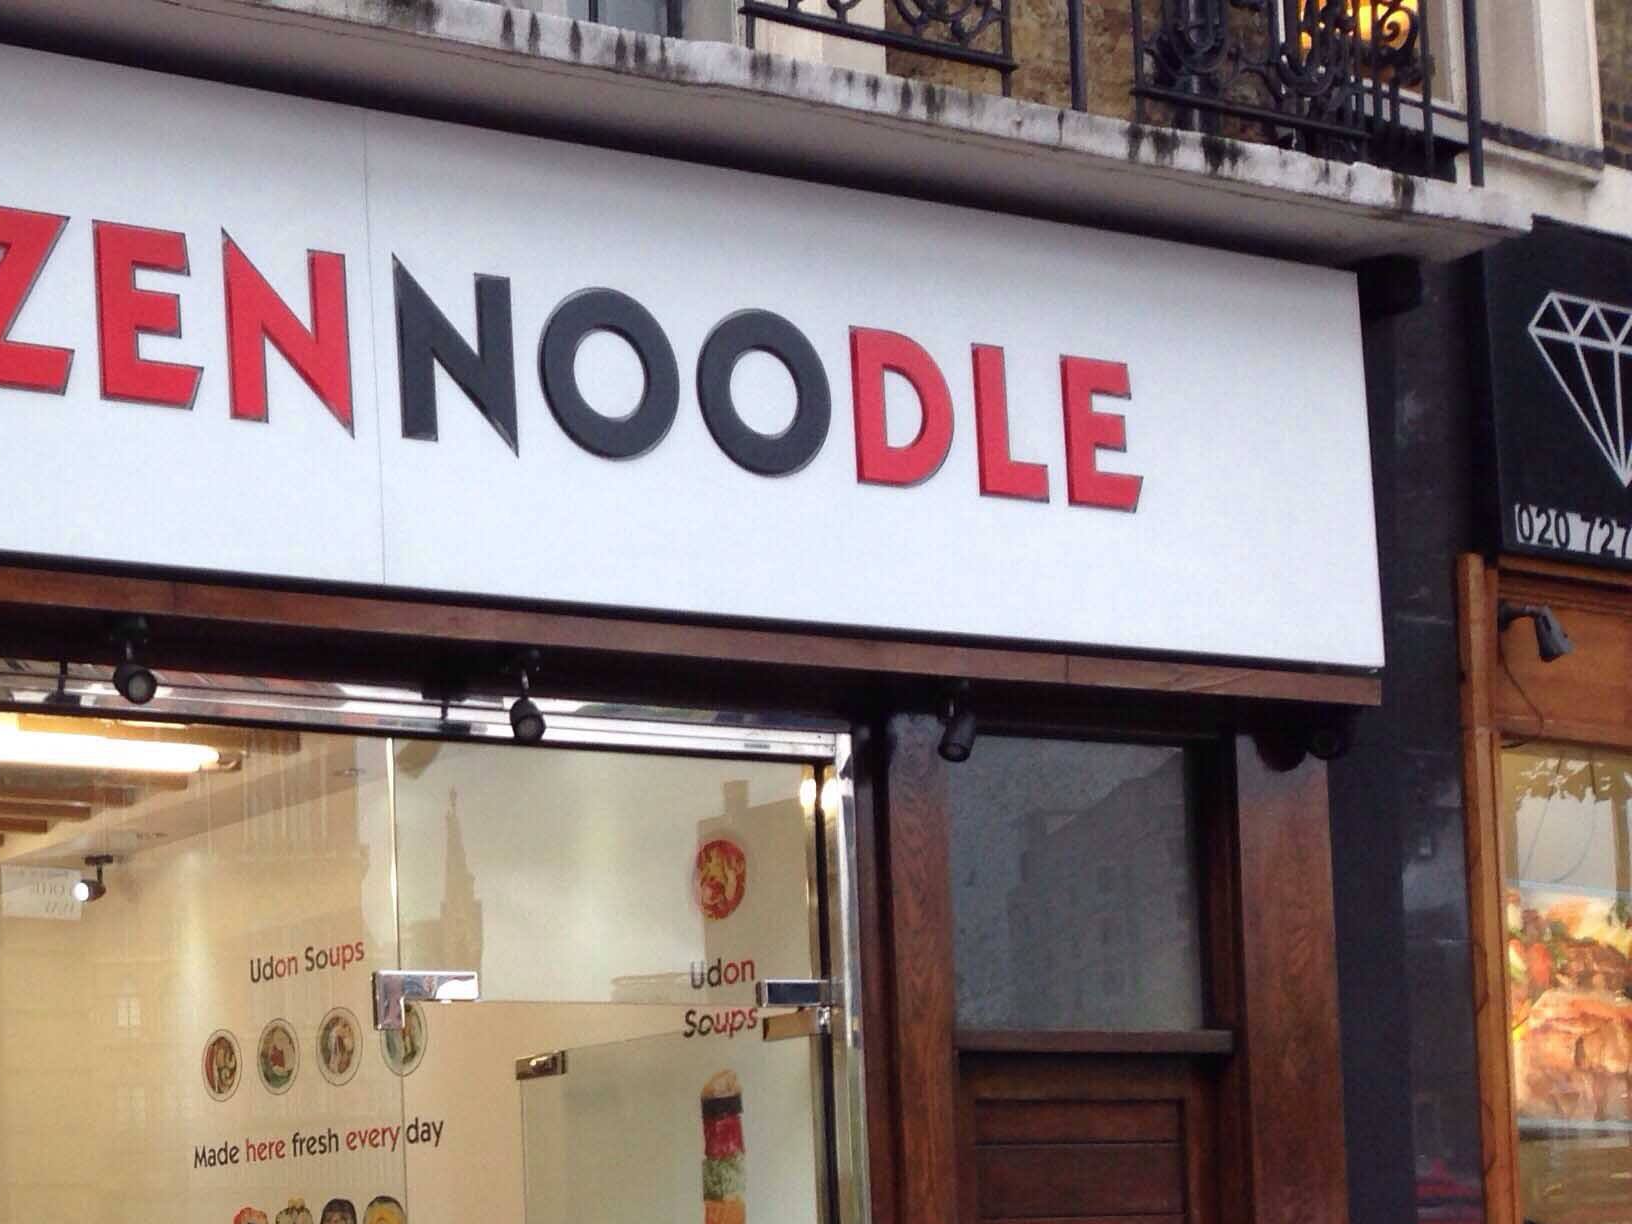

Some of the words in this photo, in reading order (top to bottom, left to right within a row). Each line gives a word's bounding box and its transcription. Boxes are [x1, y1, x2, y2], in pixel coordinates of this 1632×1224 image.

[1517, 502, 1571, 550] 020
[249, 956, 299, 984] Udon
[304, 941, 365, 971] Soups
[690, 957, 756, 989] Udon
[683, 1007, 759, 1038] Soups
[193, 1141, 240, 1168] Made
[245, 1138, 286, 1162] here
[291, 1128, 340, 1157] fresh
[346, 1125, 401, 1152] every
[406, 1116, 445, 1148] day
